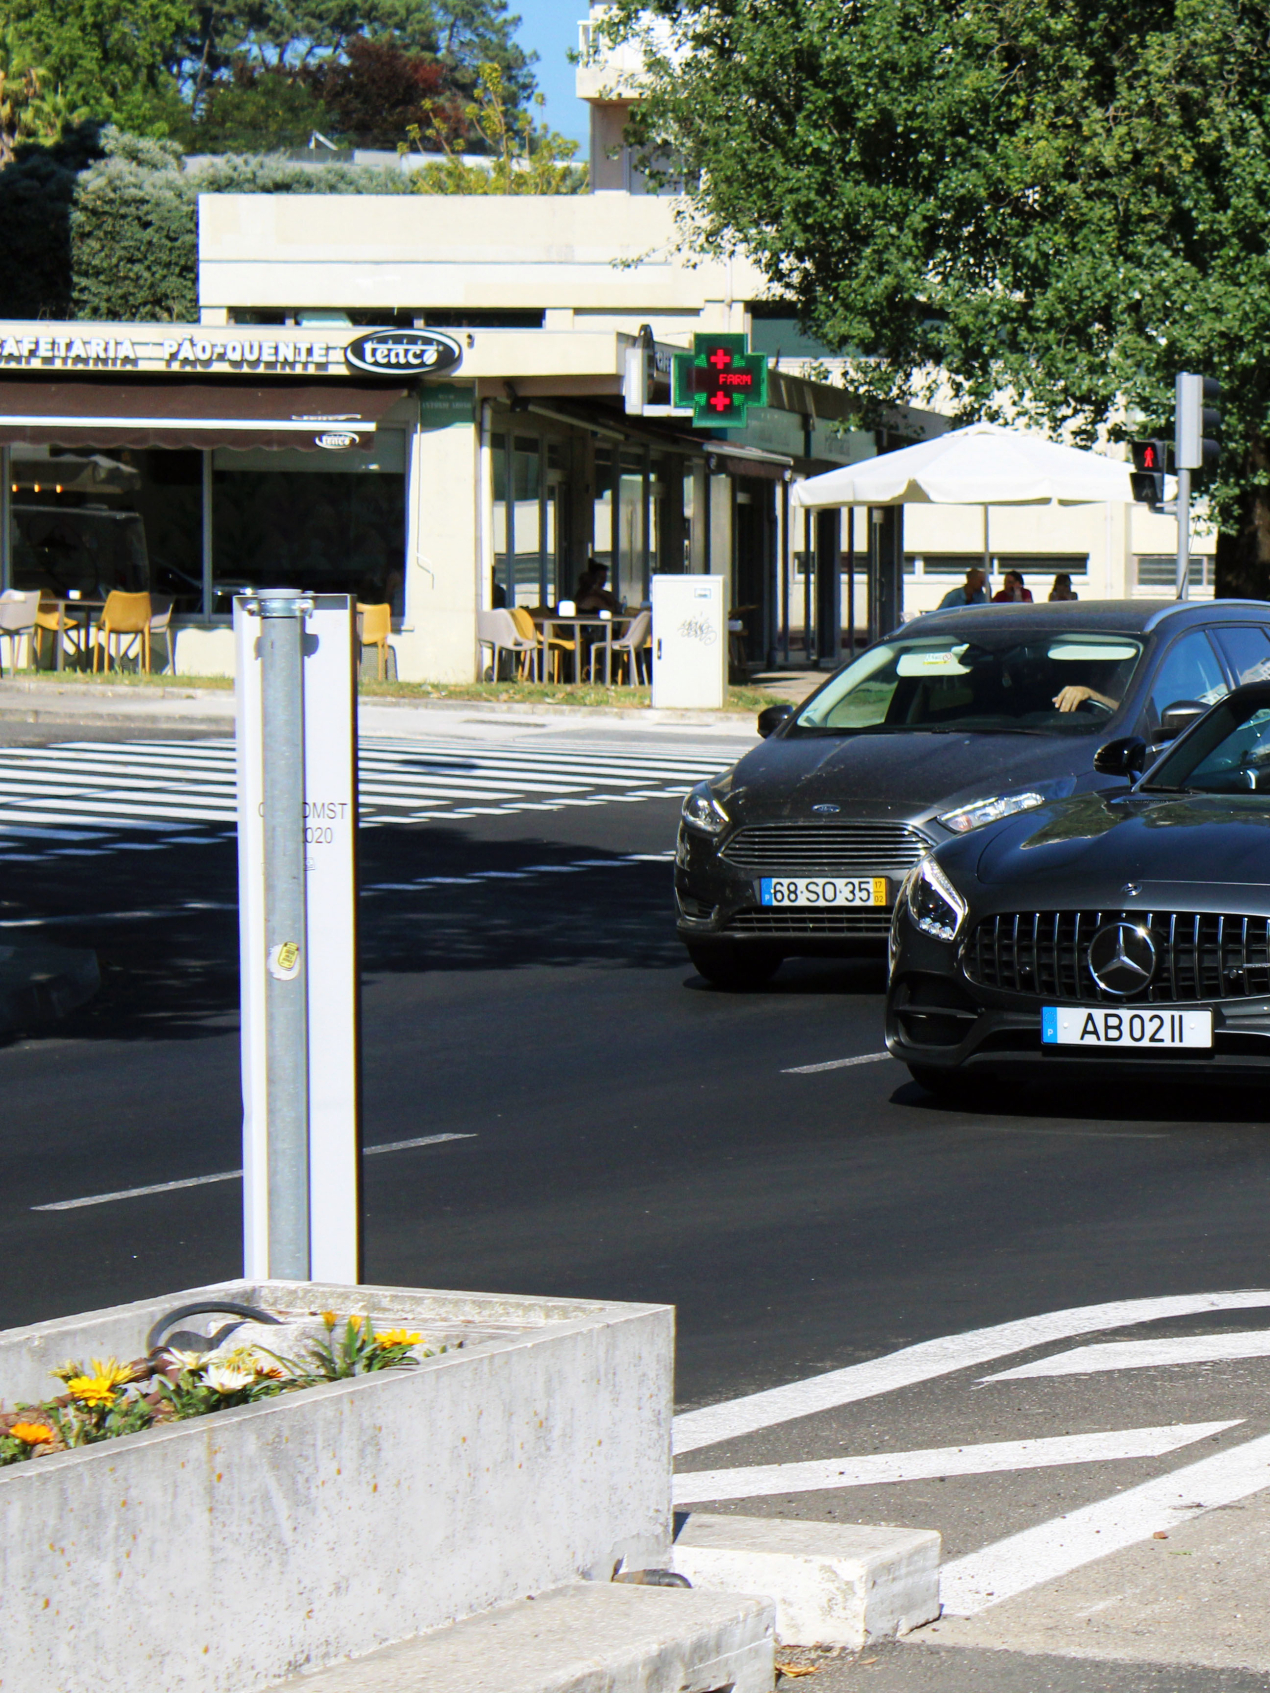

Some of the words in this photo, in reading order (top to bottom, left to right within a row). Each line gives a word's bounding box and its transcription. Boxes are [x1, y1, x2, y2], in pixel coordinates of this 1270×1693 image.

[0, 336, 137, 359] AFETARIA
[163, 334, 328, 363] PÃO-QUENTE
[718, 373, 752, 386] FARM
[302, 826, 333, 844] 020
